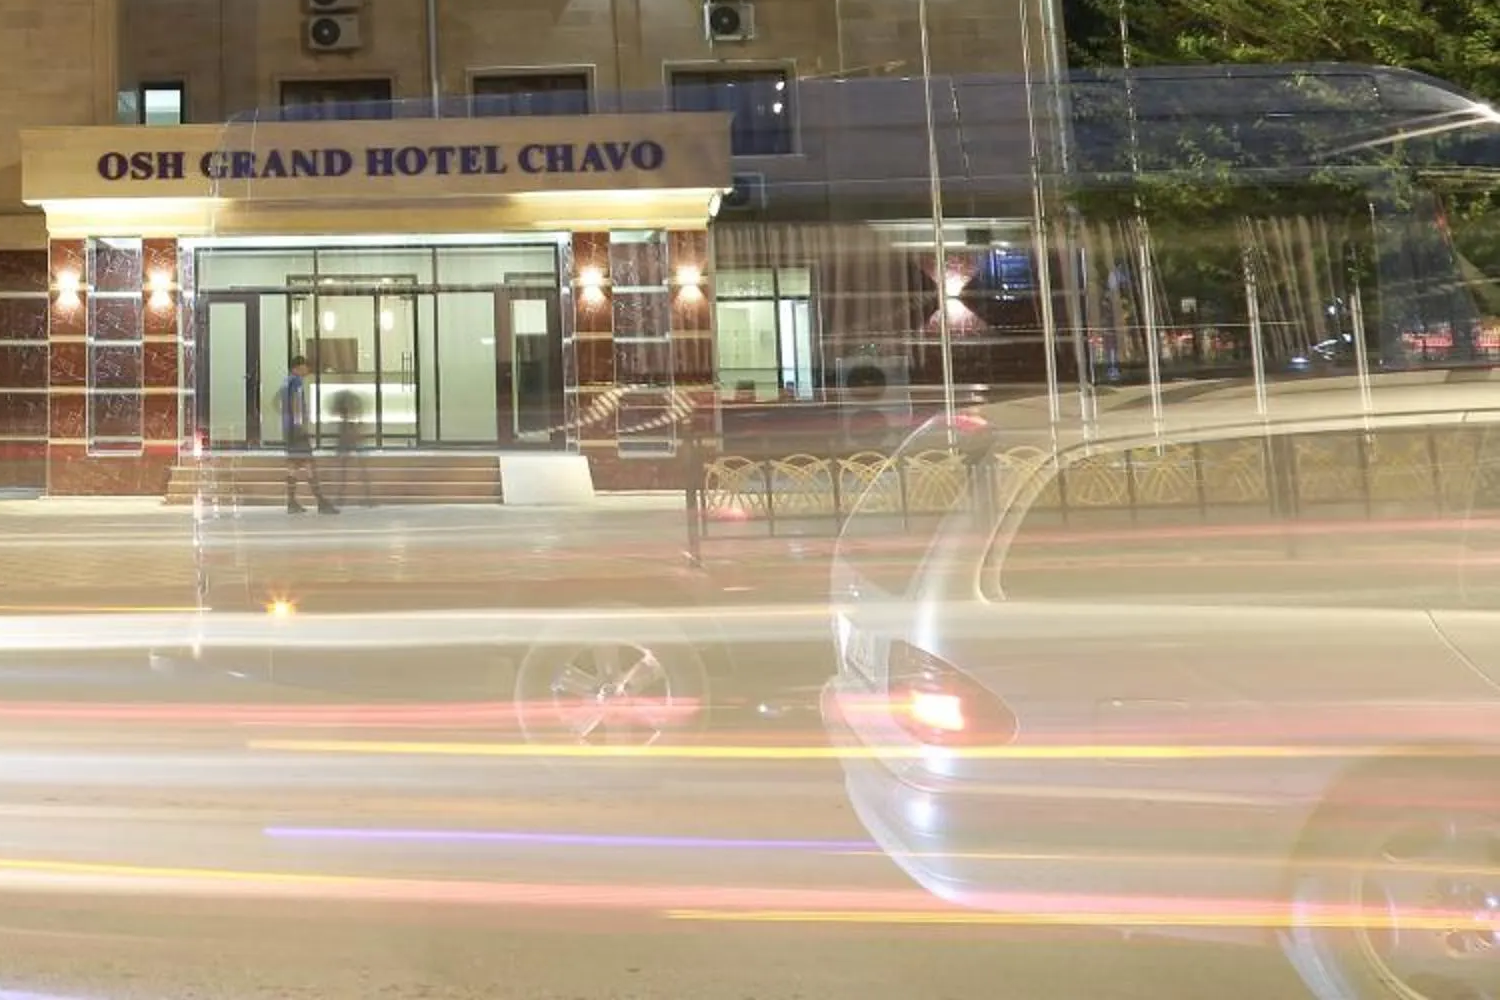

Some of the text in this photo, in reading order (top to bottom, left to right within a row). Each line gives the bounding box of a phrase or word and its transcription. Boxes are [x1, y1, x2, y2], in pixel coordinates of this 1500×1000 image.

[97, 140, 664, 180] OSH GRAND HOTEL CHAVO
